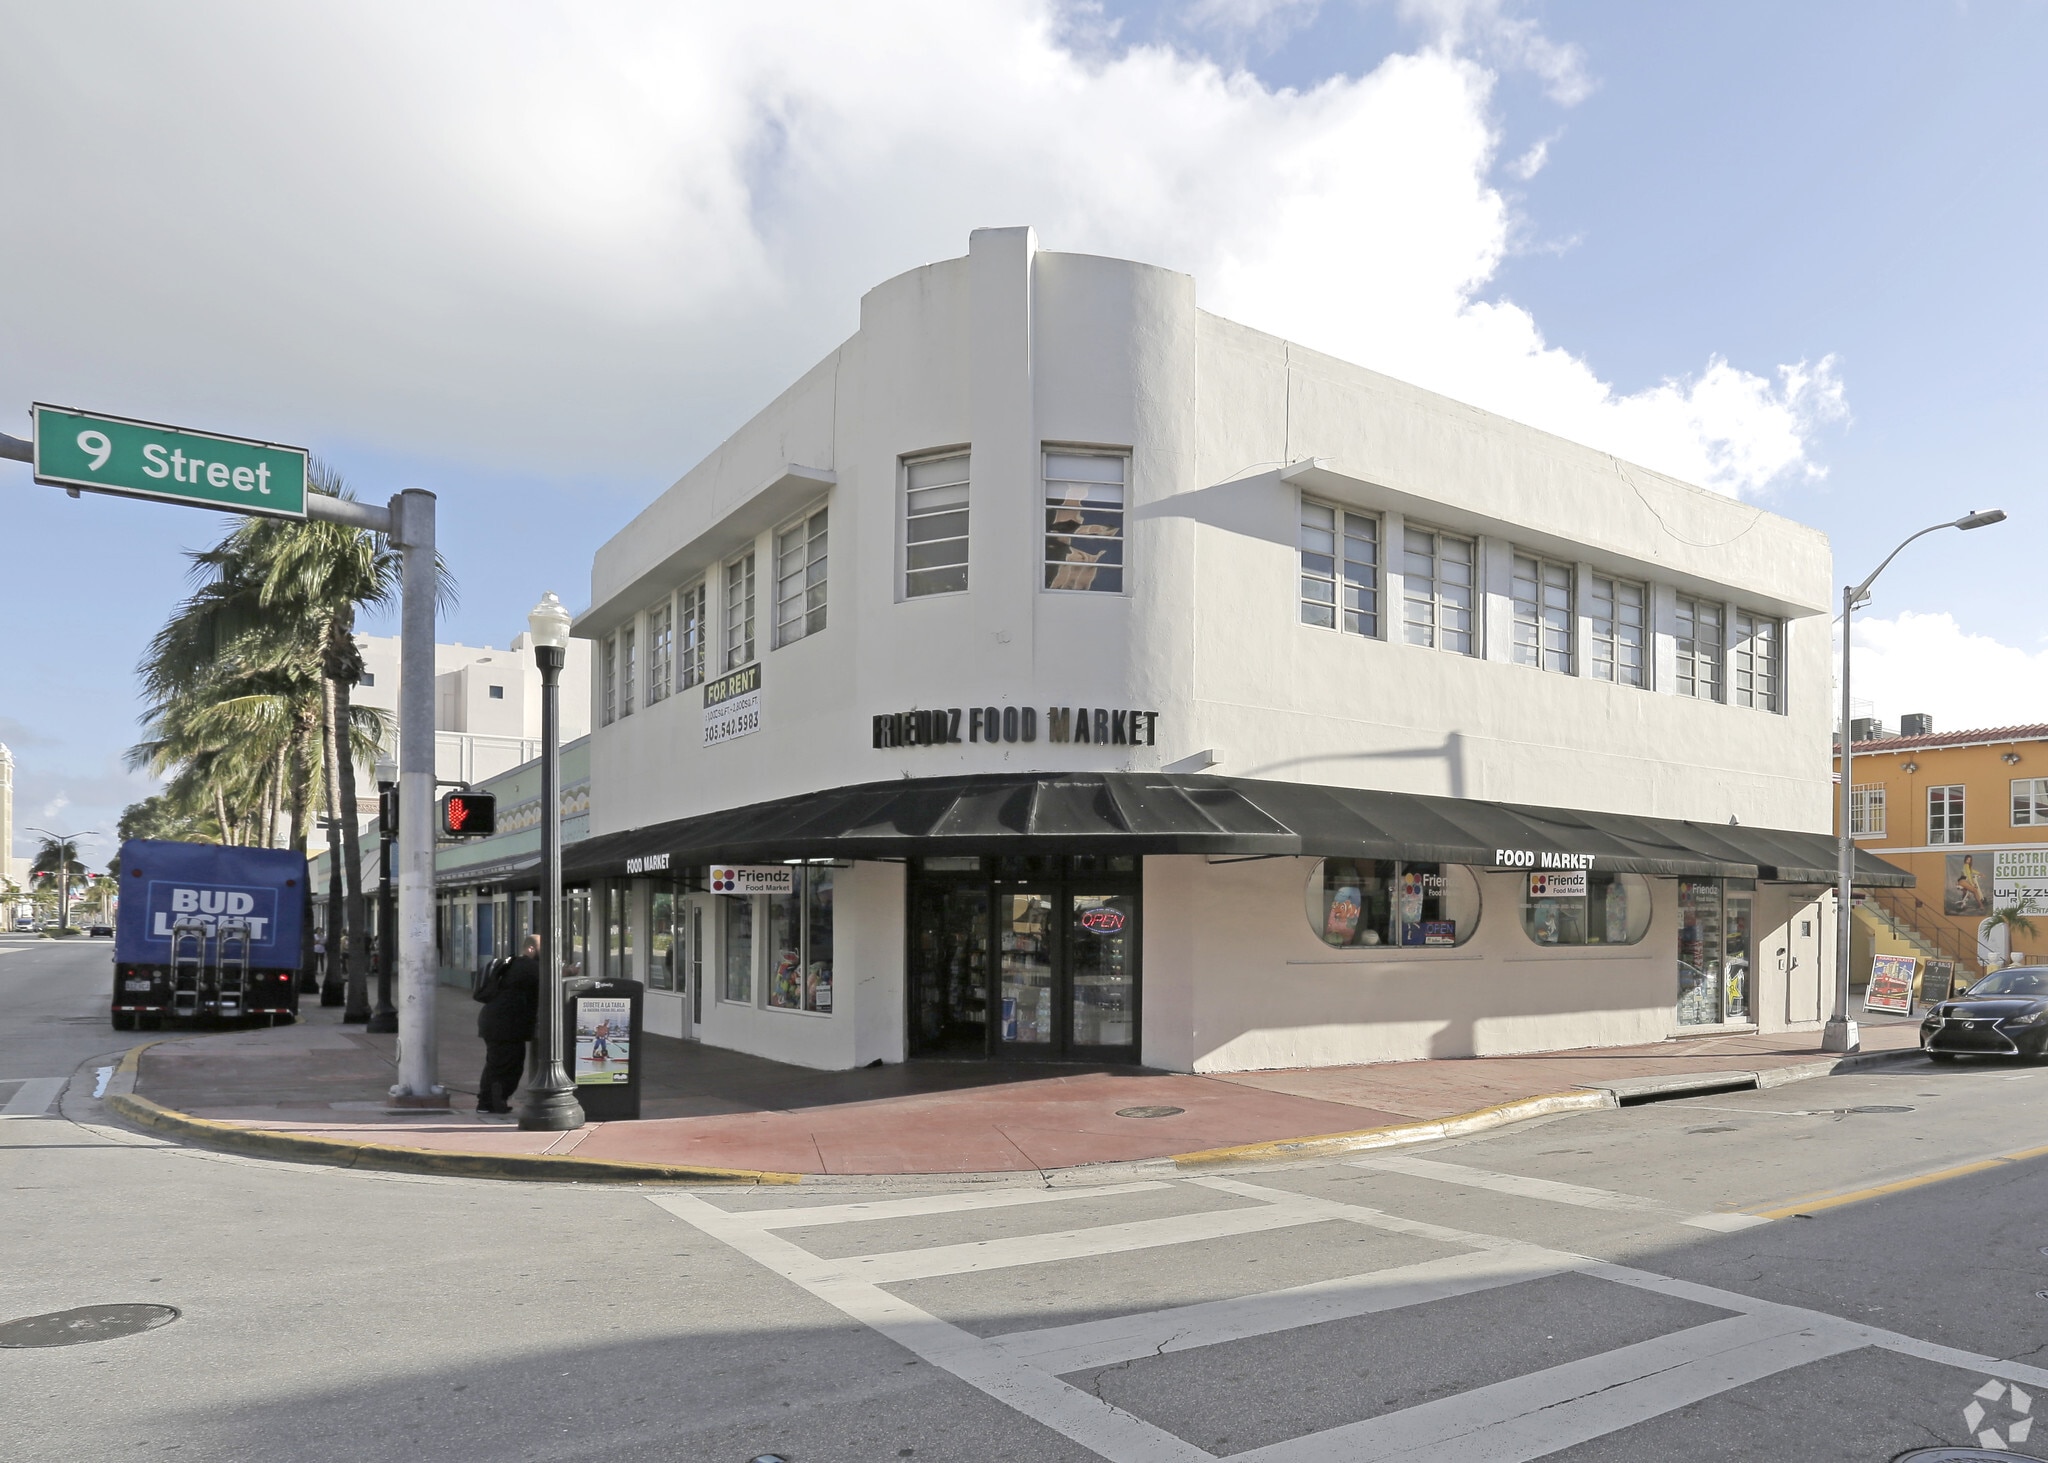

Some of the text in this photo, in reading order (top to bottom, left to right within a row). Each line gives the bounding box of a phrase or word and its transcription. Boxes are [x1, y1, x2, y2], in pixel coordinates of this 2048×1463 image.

[76, 430, 272, 495] 9 Street
[708, 668, 756, 704] FOR RENT
[704, 710, 759, 742] 305.542.5983
[969, 706, 1037, 743] FOOD
[1049, 706, 1159, 746] MARKET
[627, 853, 670, 874] FOOD MARKET
[1496, 849, 1596, 869] FOOD MARKET
[737, 869, 790, 882] Friendz
[1547, 874, 1585, 886] Friendz
[1995, 865, 2047, 877] SCOOTER
[172, 888, 255, 915] BUD
[153, 912, 269, 940] LIGHT
[1082, 913, 1126, 929] OPEN
[1426, 923, 1454, 934] OPEN
